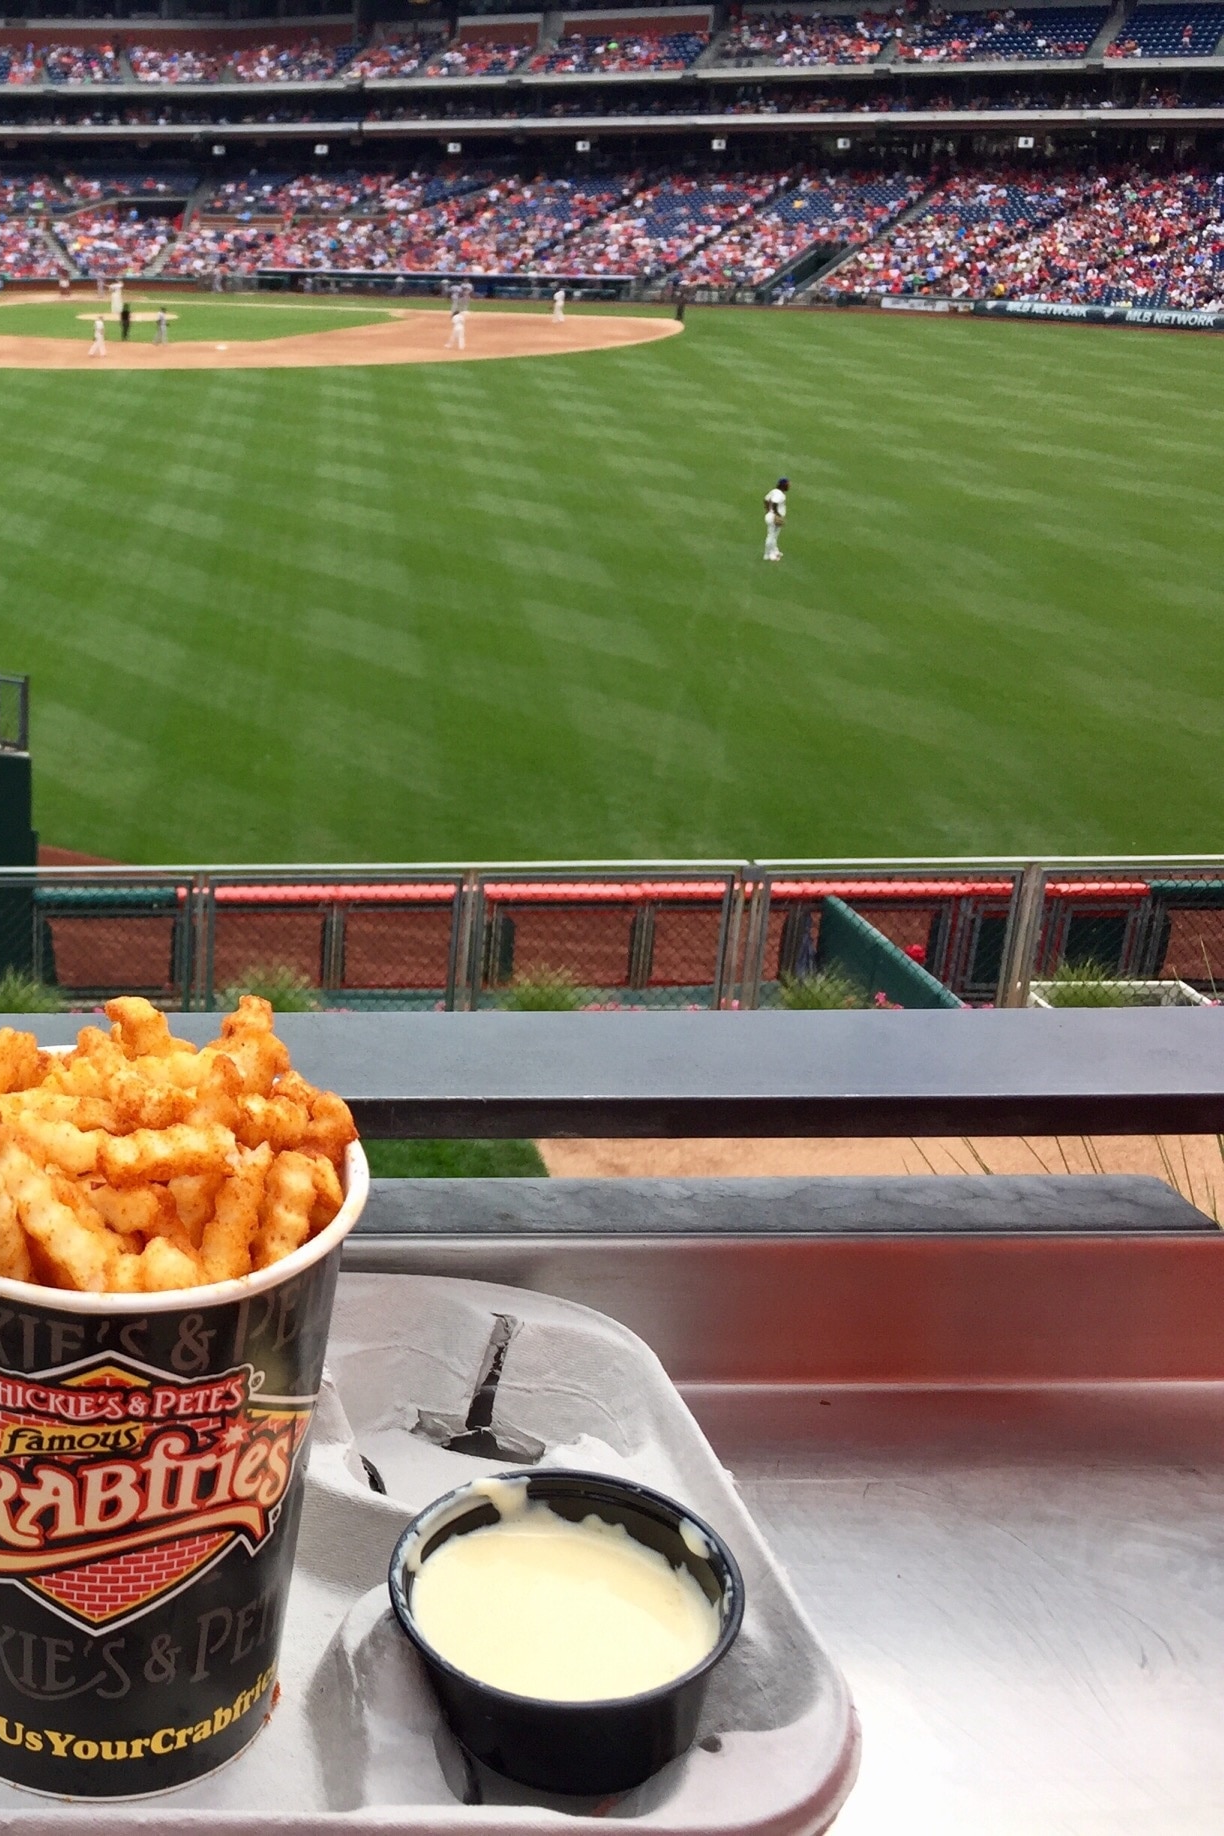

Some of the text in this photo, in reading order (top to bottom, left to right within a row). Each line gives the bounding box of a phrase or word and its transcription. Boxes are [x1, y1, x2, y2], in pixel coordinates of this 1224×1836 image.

[1006, 299, 1089, 317] MLB NETWORK
[1125, 310, 1216, 327] MLB NETWORK
[170, 1312, 217, 1372] &
[127, 1395, 146, 1418] &
[151, 1378, 243, 1418] PETE'S
[3, 1424, 141, 1454] famous
[143, 1633, 182, 1686] &
